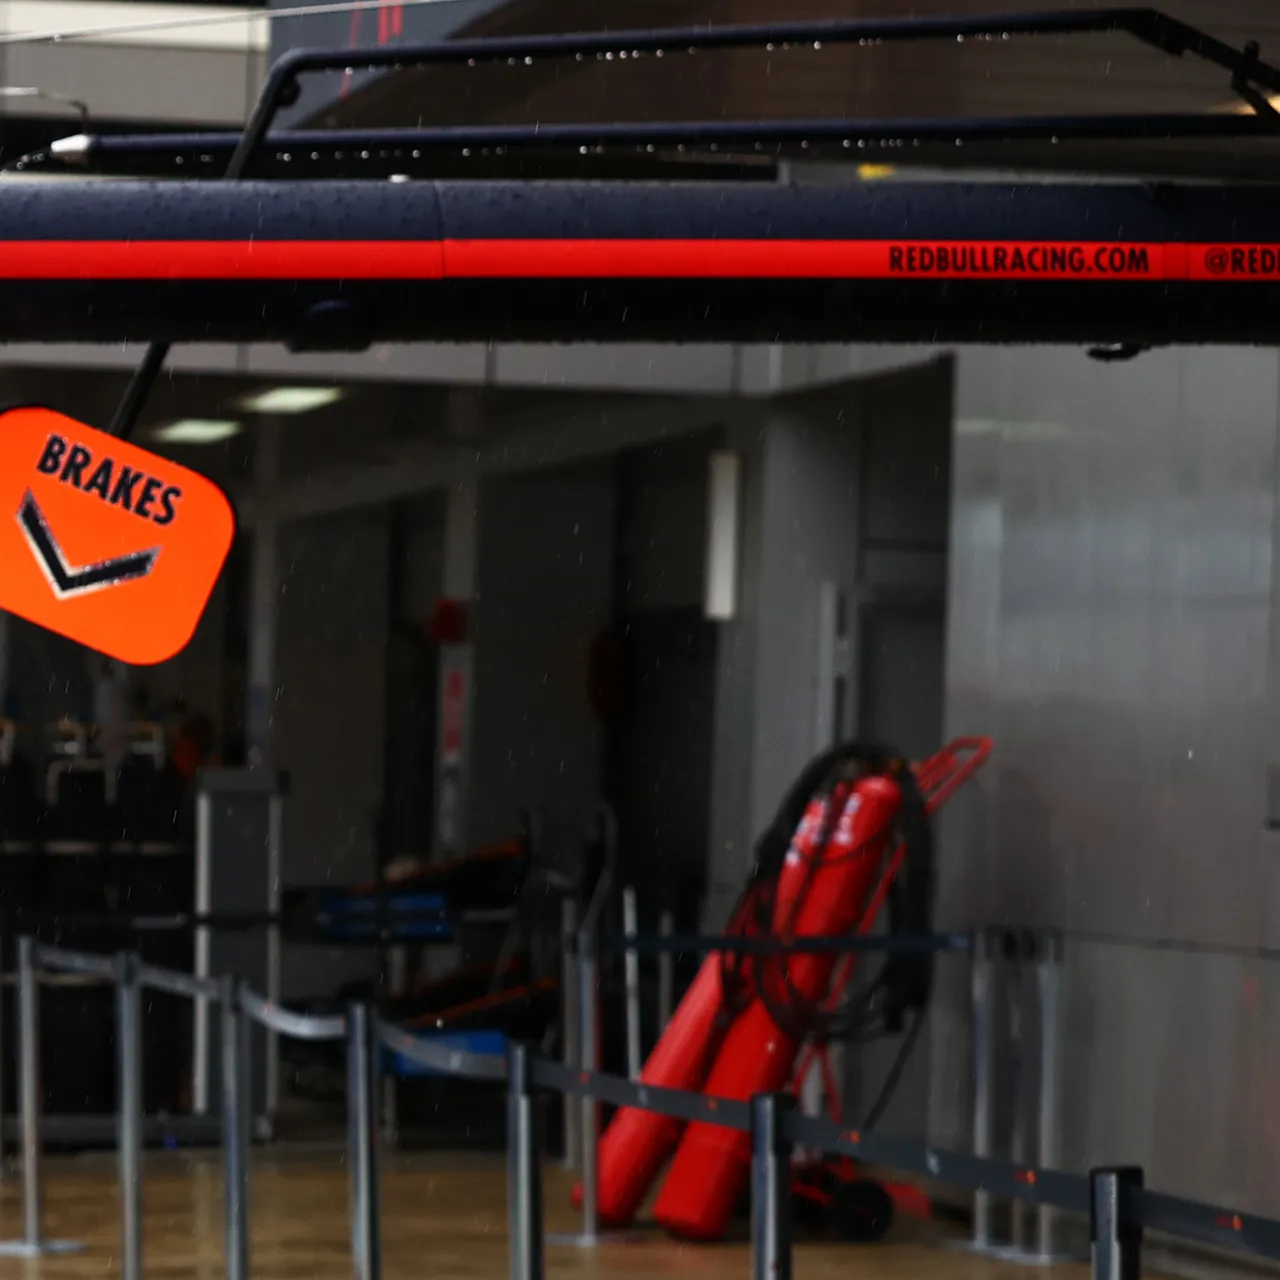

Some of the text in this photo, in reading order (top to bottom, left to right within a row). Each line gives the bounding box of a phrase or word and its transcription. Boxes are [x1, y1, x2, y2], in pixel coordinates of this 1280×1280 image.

[889, 246, 1149, 273] REDBULLRACING.COM
[1203, 247, 1280, 275] @RED
[36, 432, 183, 526] BRAKES
